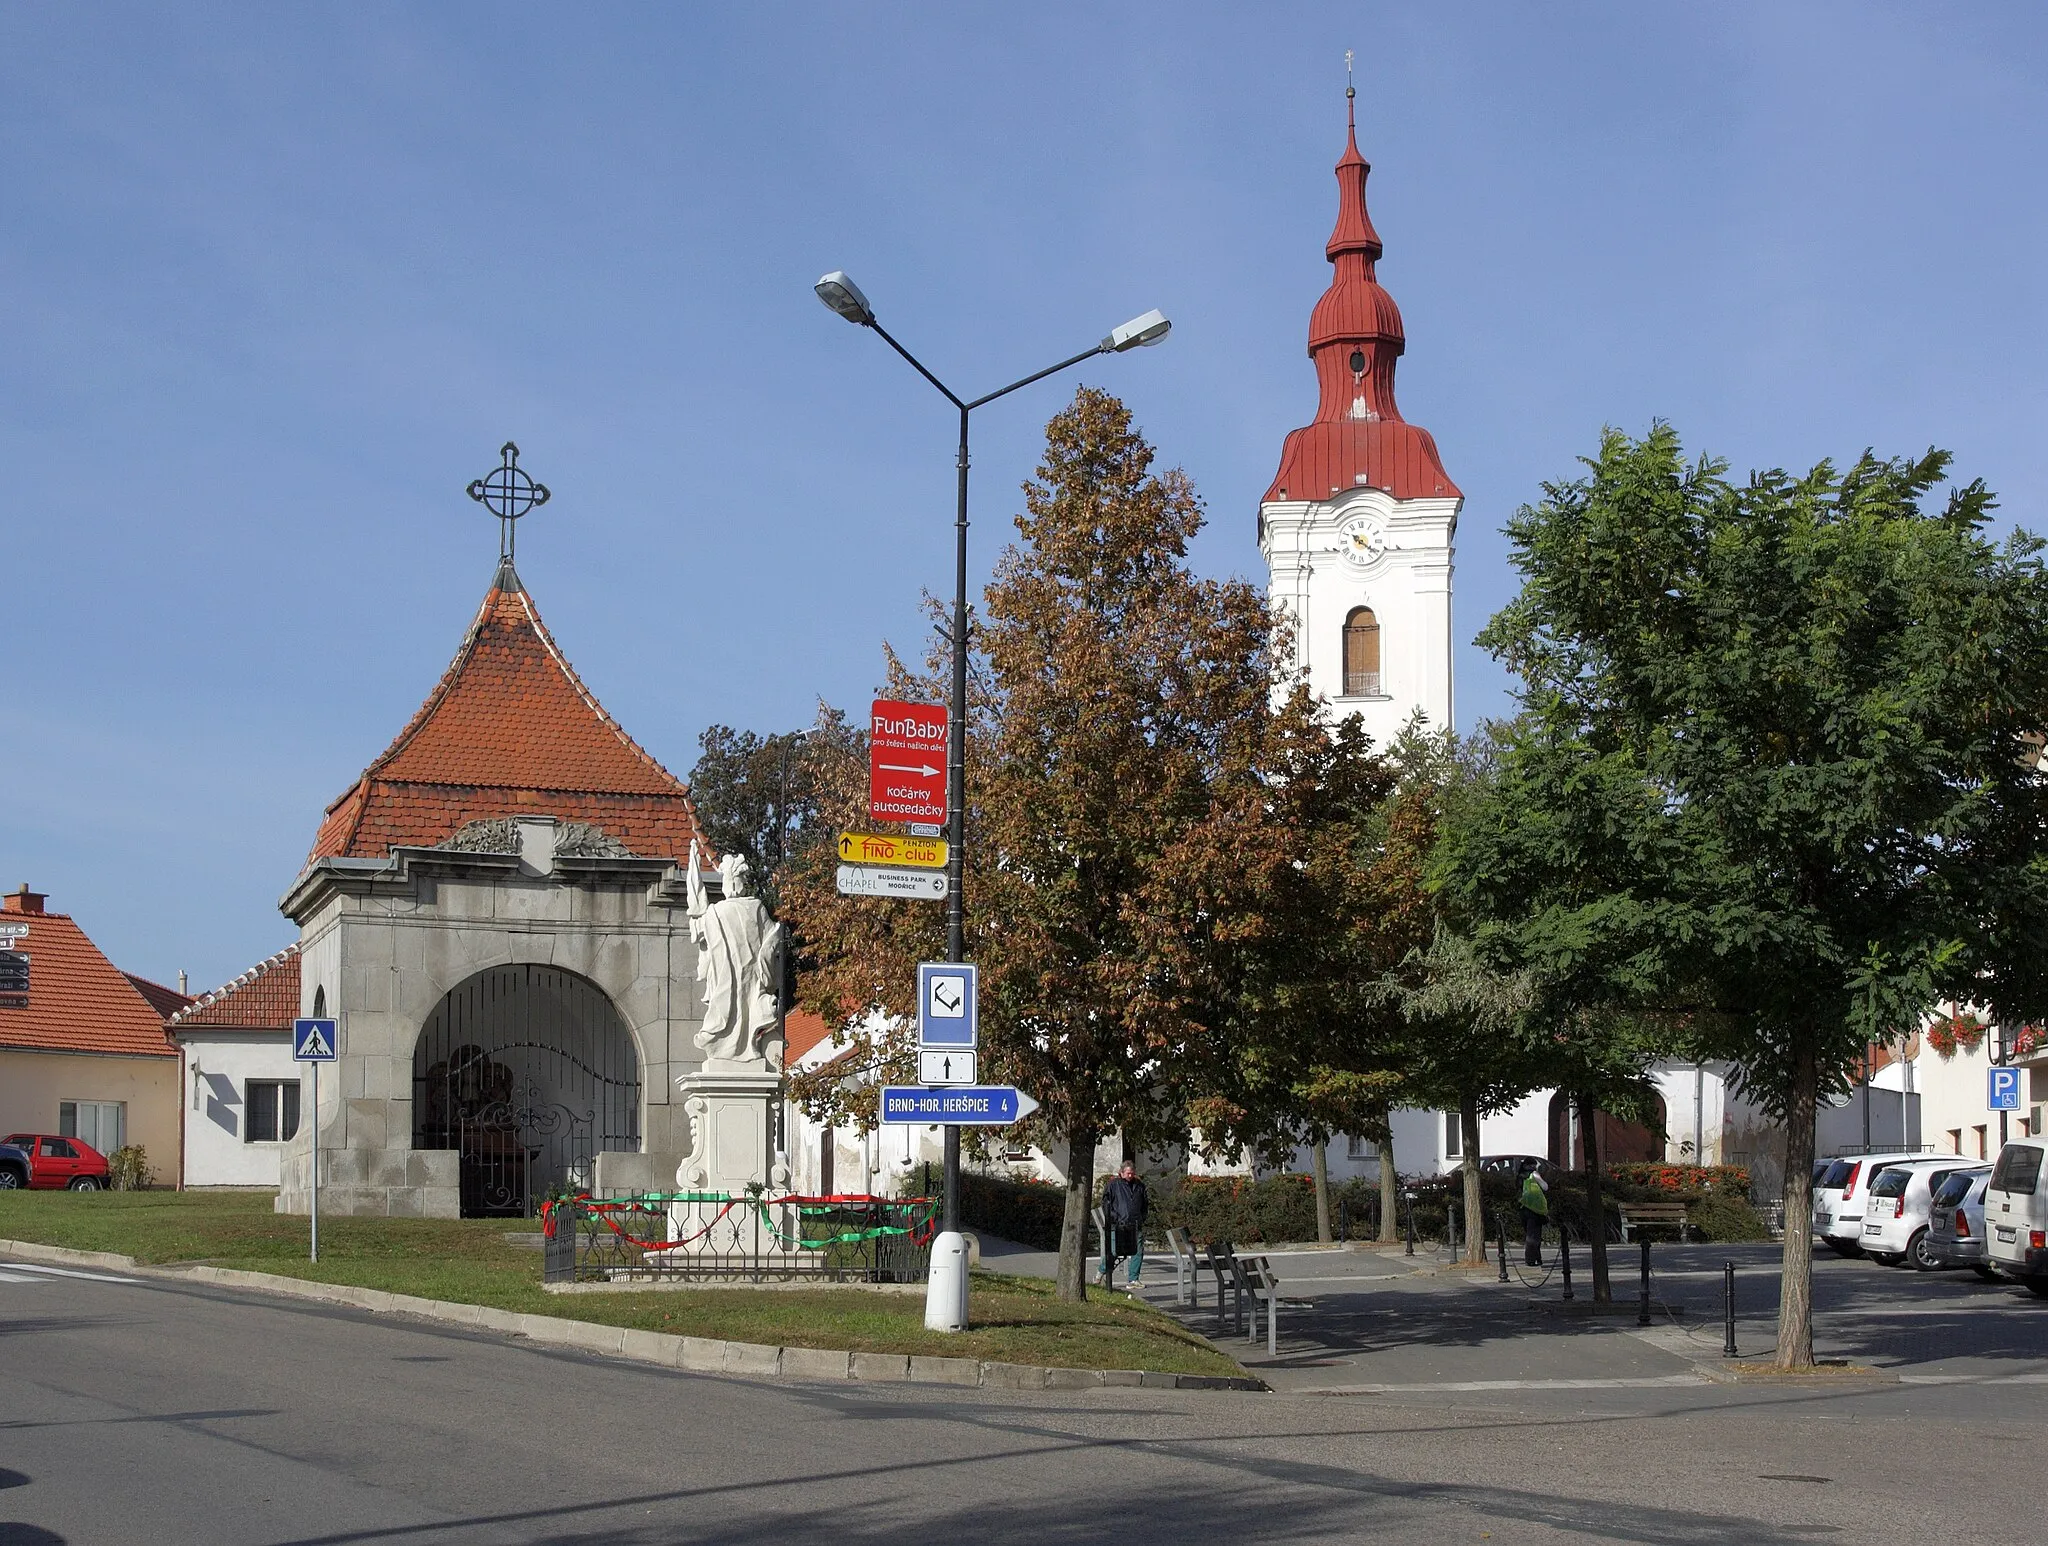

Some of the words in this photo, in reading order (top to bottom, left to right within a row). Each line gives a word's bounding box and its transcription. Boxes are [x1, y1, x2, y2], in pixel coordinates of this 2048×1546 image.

[873, 716, 945, 740] FunBaby
[872, 739, 885, 747] pro
[886, 739, 906, 749] štěstí
[907, 741, 929, 751] našich
[930, 743, 945, 752] dětí
[873, 801, 944, 817] autosedačky
[902, 839, 937, 848] PENZION
[905, 848, 936, 862] club
[838, 877, 877, 890] CHAPEL
[878, 874, 909, 882] BUSINESS
[888, 882, 916, 890] MODŘICE
[1995, 1072, 2013, 1097] P
[888, 1098, 942, 1112] BRNO-HOR.
[943, 1095, 989, 1112] HERŠPICE
[1001, 1098, 1008, 1112] 4
